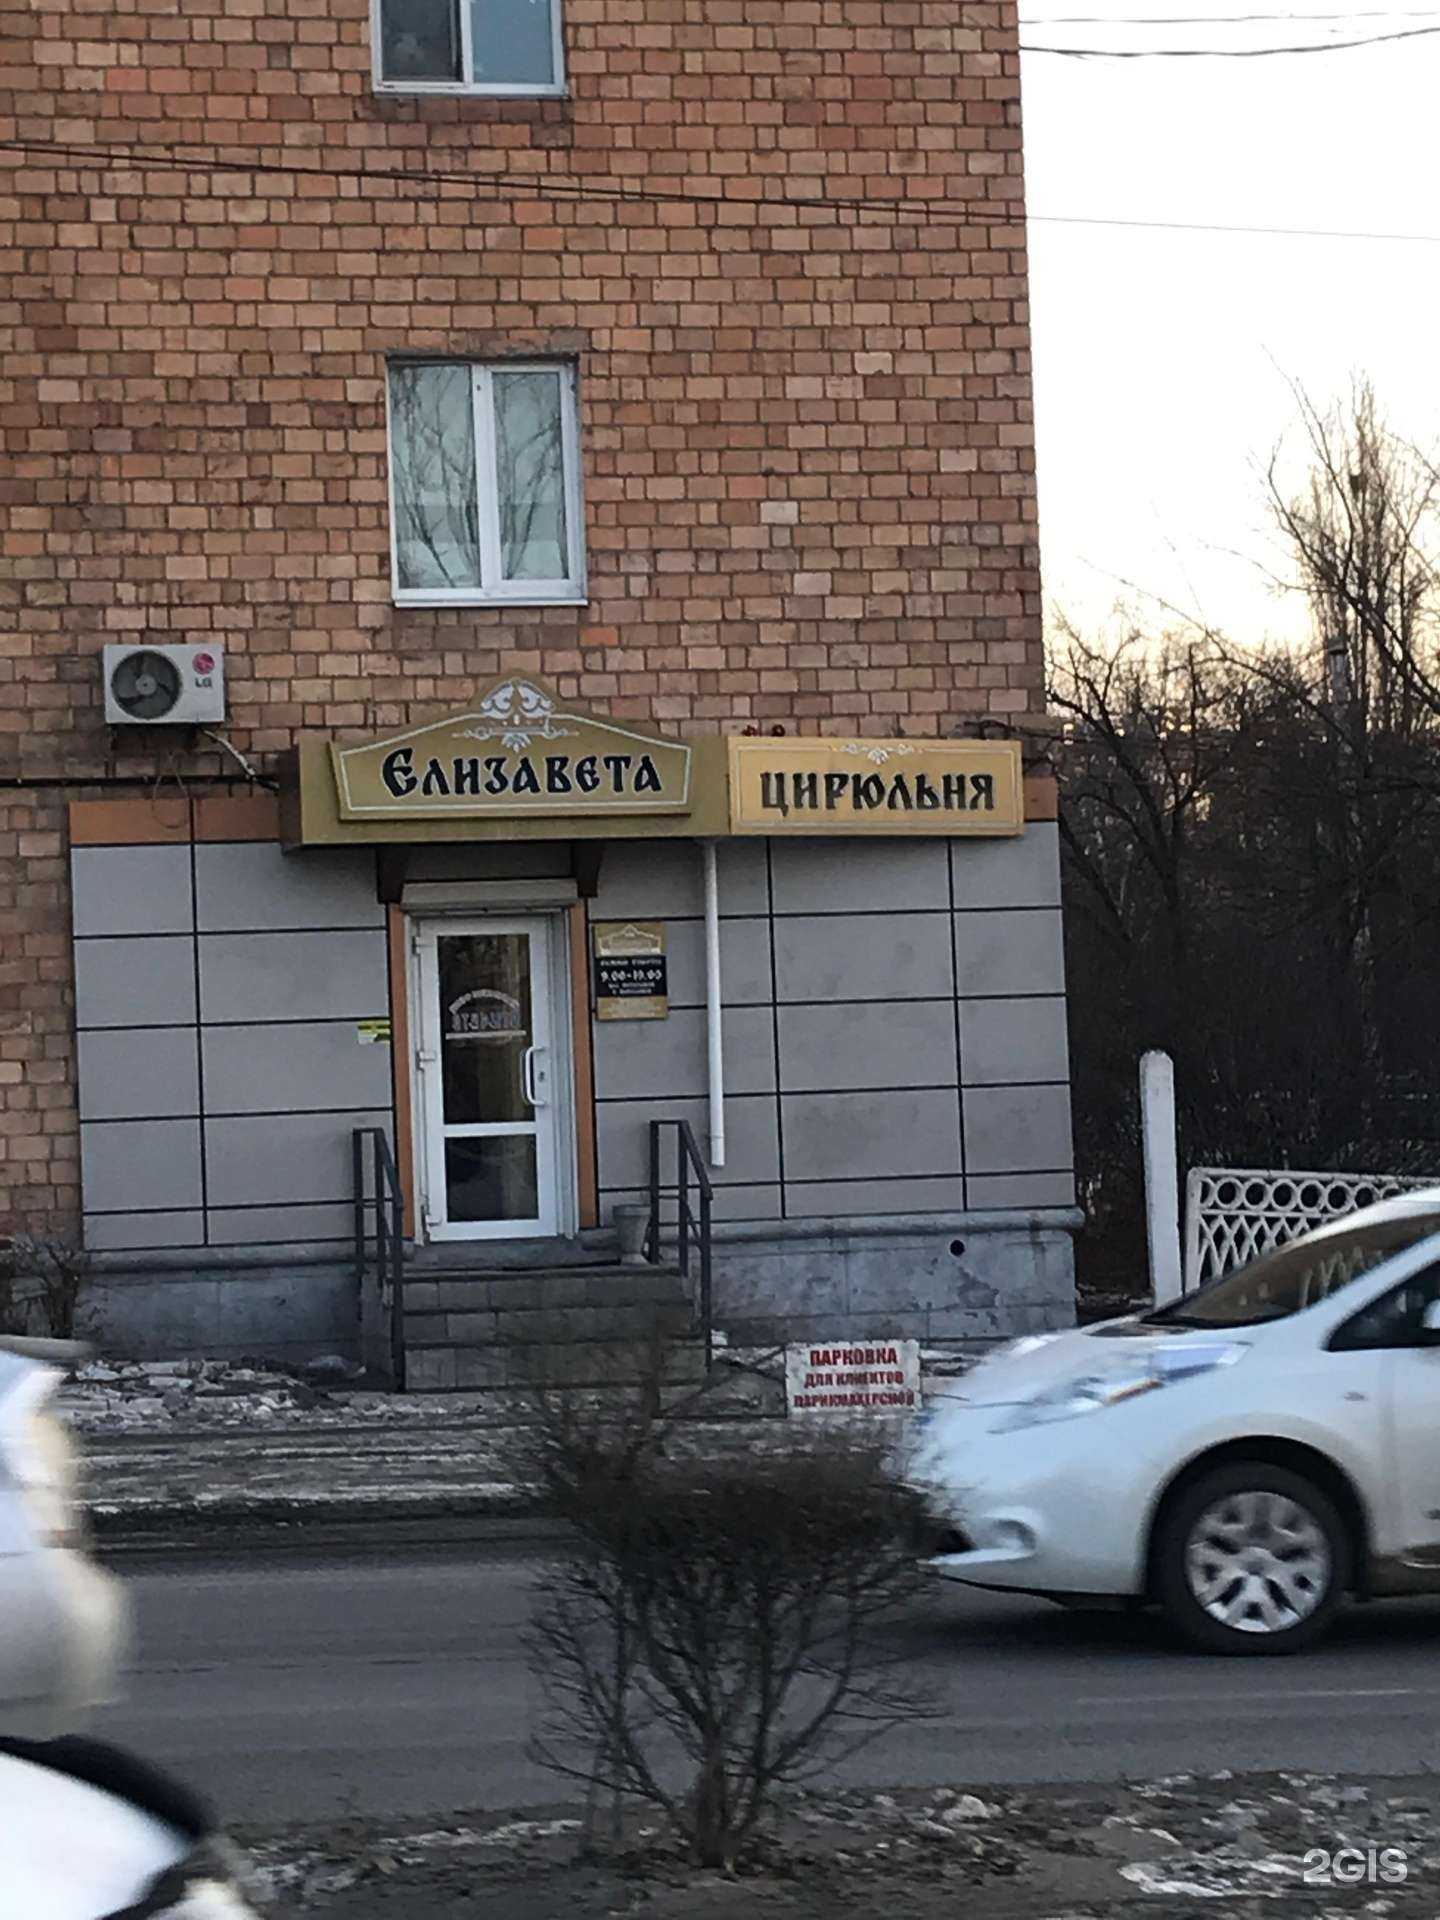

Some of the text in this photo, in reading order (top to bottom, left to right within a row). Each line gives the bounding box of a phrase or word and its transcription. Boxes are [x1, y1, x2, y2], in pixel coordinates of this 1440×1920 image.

[195, 677, 213, 689] LG
[760, 772, 994, 817] ЦИРЮЛЬНЯ
[810, 1348, 898, 1366] ПАРКОВКА
[804, 1371, 904, 1388] ДЛЯ КЛИЕНТОВ
